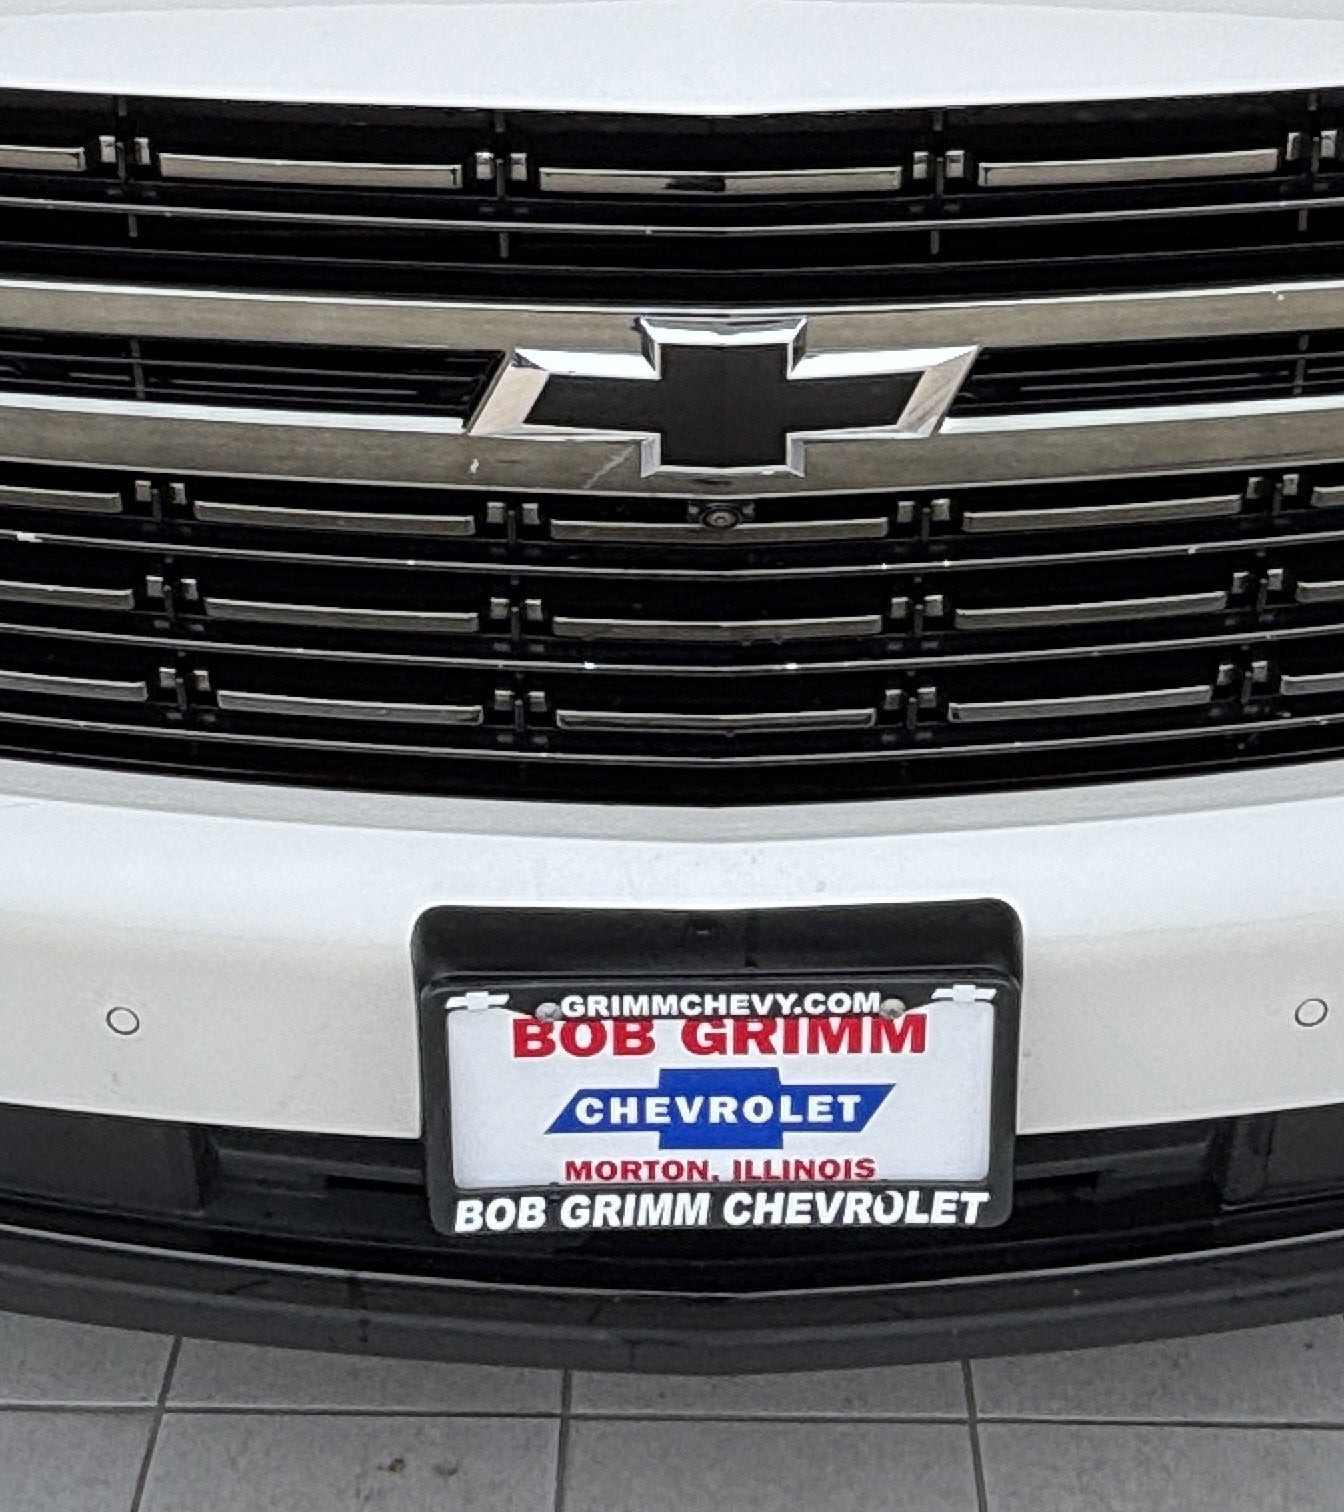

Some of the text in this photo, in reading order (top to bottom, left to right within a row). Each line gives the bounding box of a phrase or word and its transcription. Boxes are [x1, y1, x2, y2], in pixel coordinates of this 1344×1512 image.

[560, 991, 881, 1018] GRIMMCHEVY.COM
[512, 1013, 927, 1058] BOB GRIMM
[575, 1093, 862, 1126] CHEVROLET
[732, 1157, 877, 1181] ILLINOIS
[455, 1189, 991, 1232] BOB GRIMM CHEVROLET
